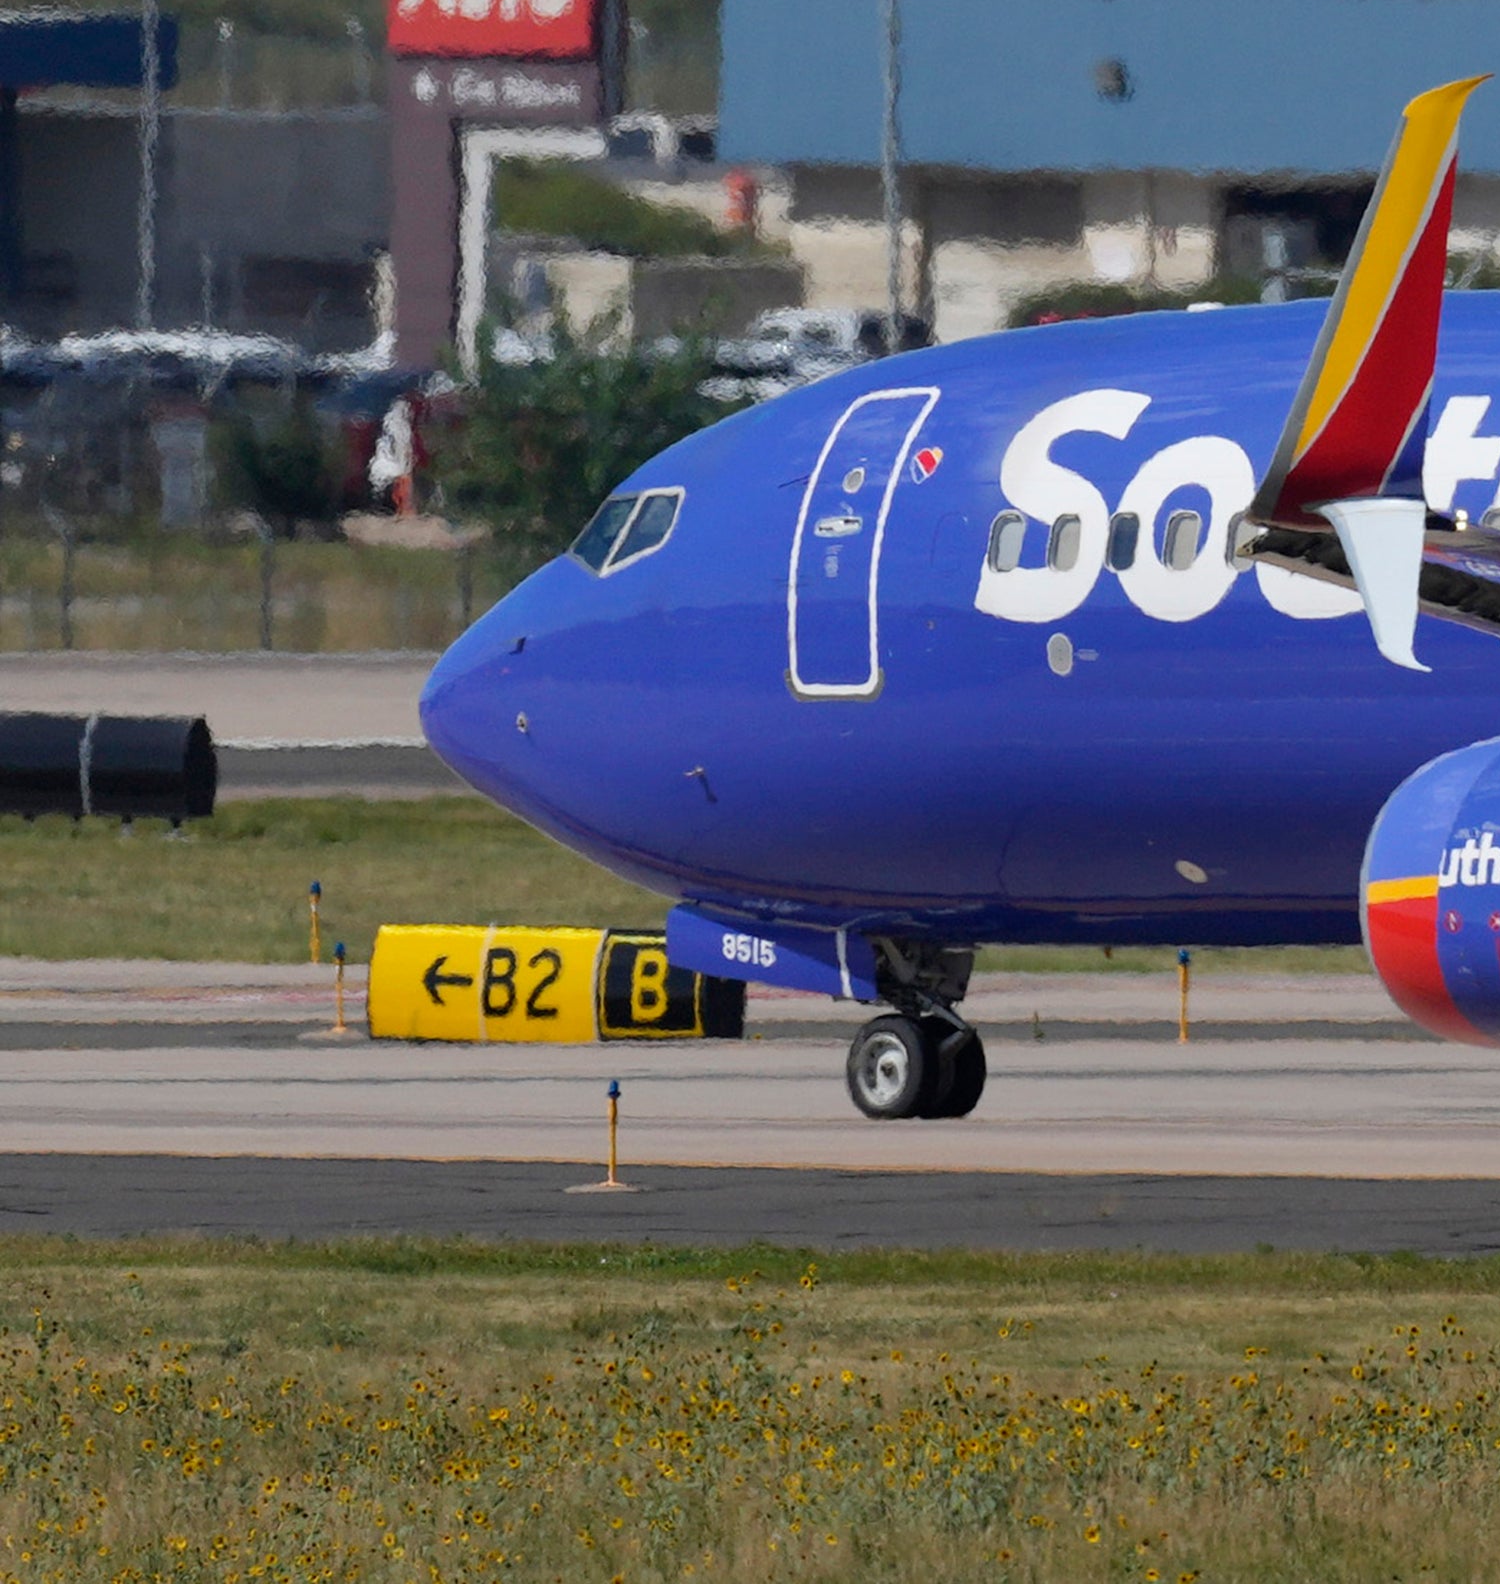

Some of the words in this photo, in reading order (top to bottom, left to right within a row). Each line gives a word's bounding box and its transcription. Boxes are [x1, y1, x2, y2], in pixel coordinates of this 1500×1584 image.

[722, 932, 776, 968] 8515
[482, 947, 562, 1018] B2
[631, 948, 669, 1023] B
